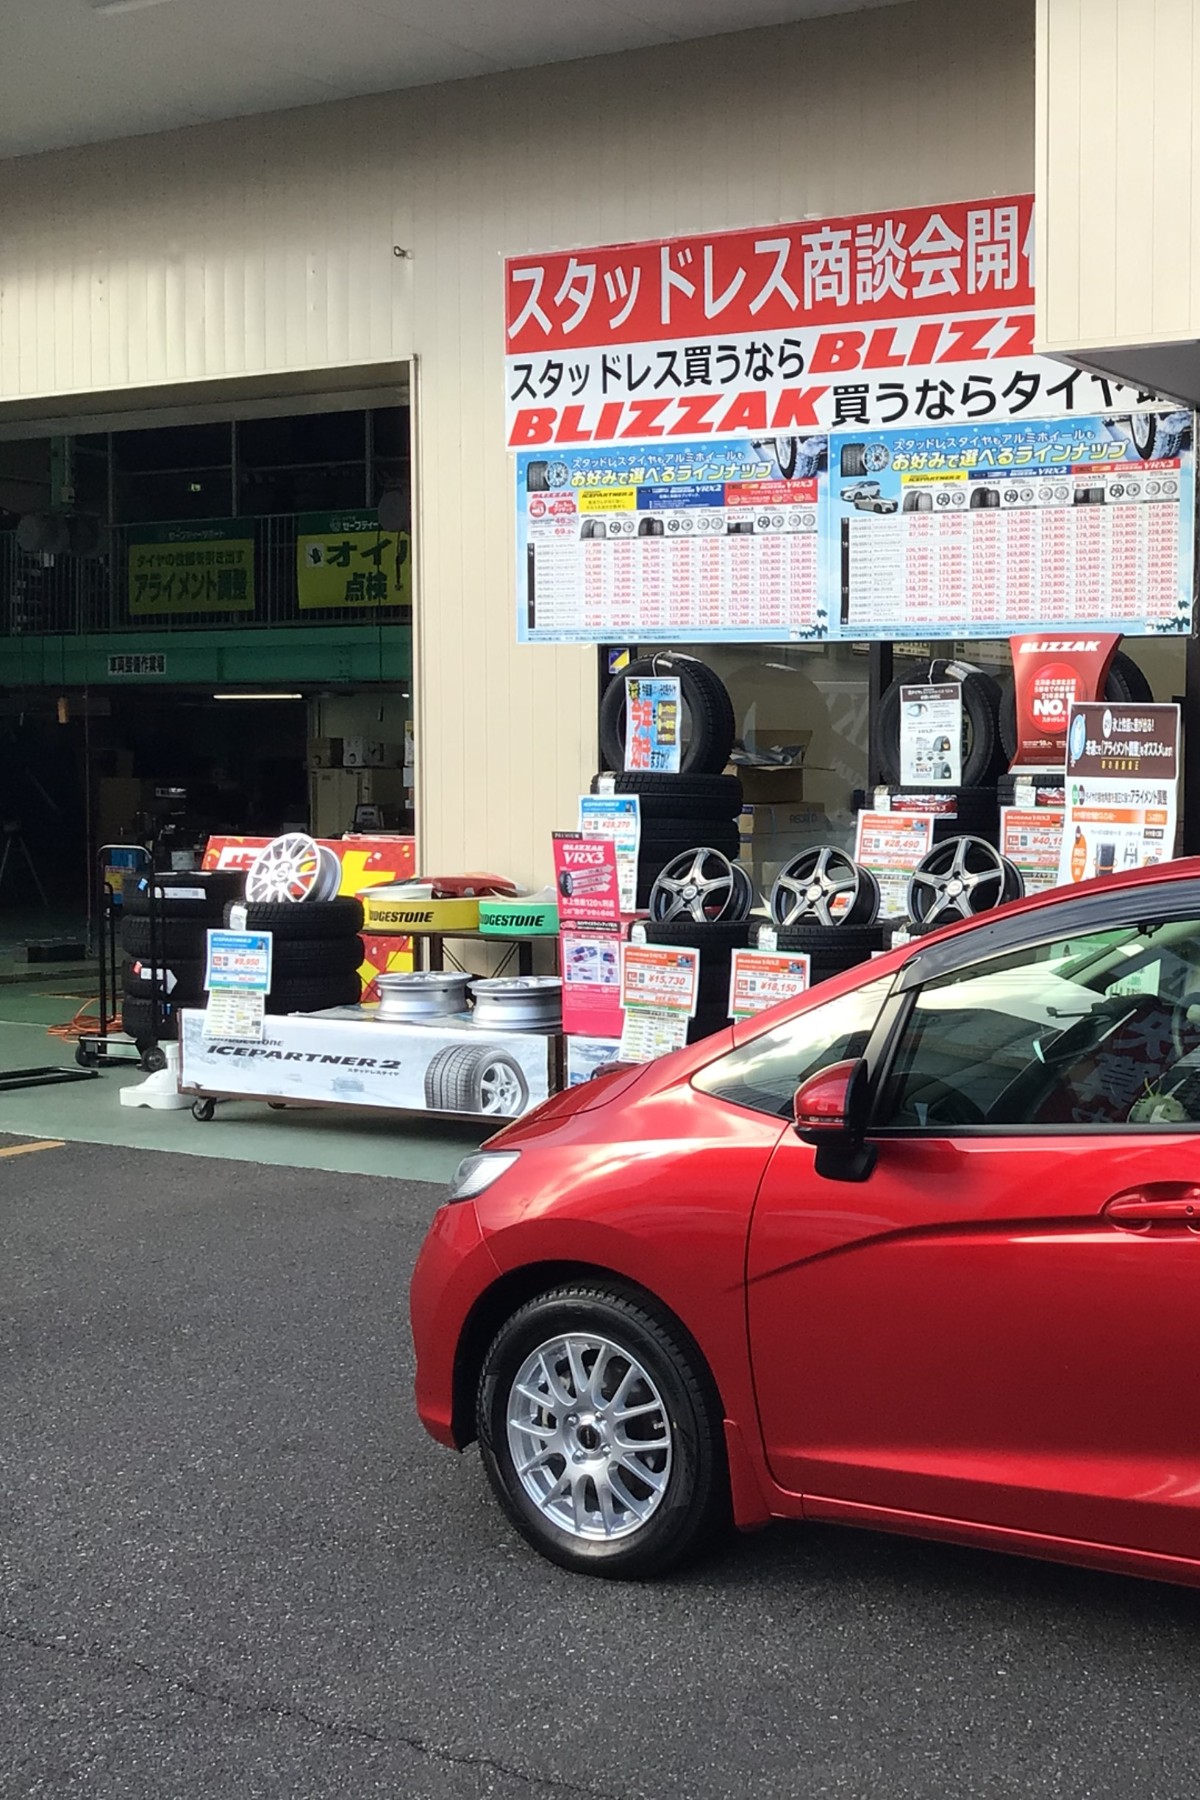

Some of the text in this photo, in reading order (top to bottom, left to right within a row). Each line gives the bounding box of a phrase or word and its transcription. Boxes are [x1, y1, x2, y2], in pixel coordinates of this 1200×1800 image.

[507, 204, 1035, 340] スタッドレス商談会開
[832, 368, 1165, 427] 買うならタイヤ
[344, 572, 388, 601] 点検
[1019, 641, 1101, 654] BLIZZAK
[563, 852, 605, 864] VRX3
[207, 1045, 378, 1069] ICEPARTNER
